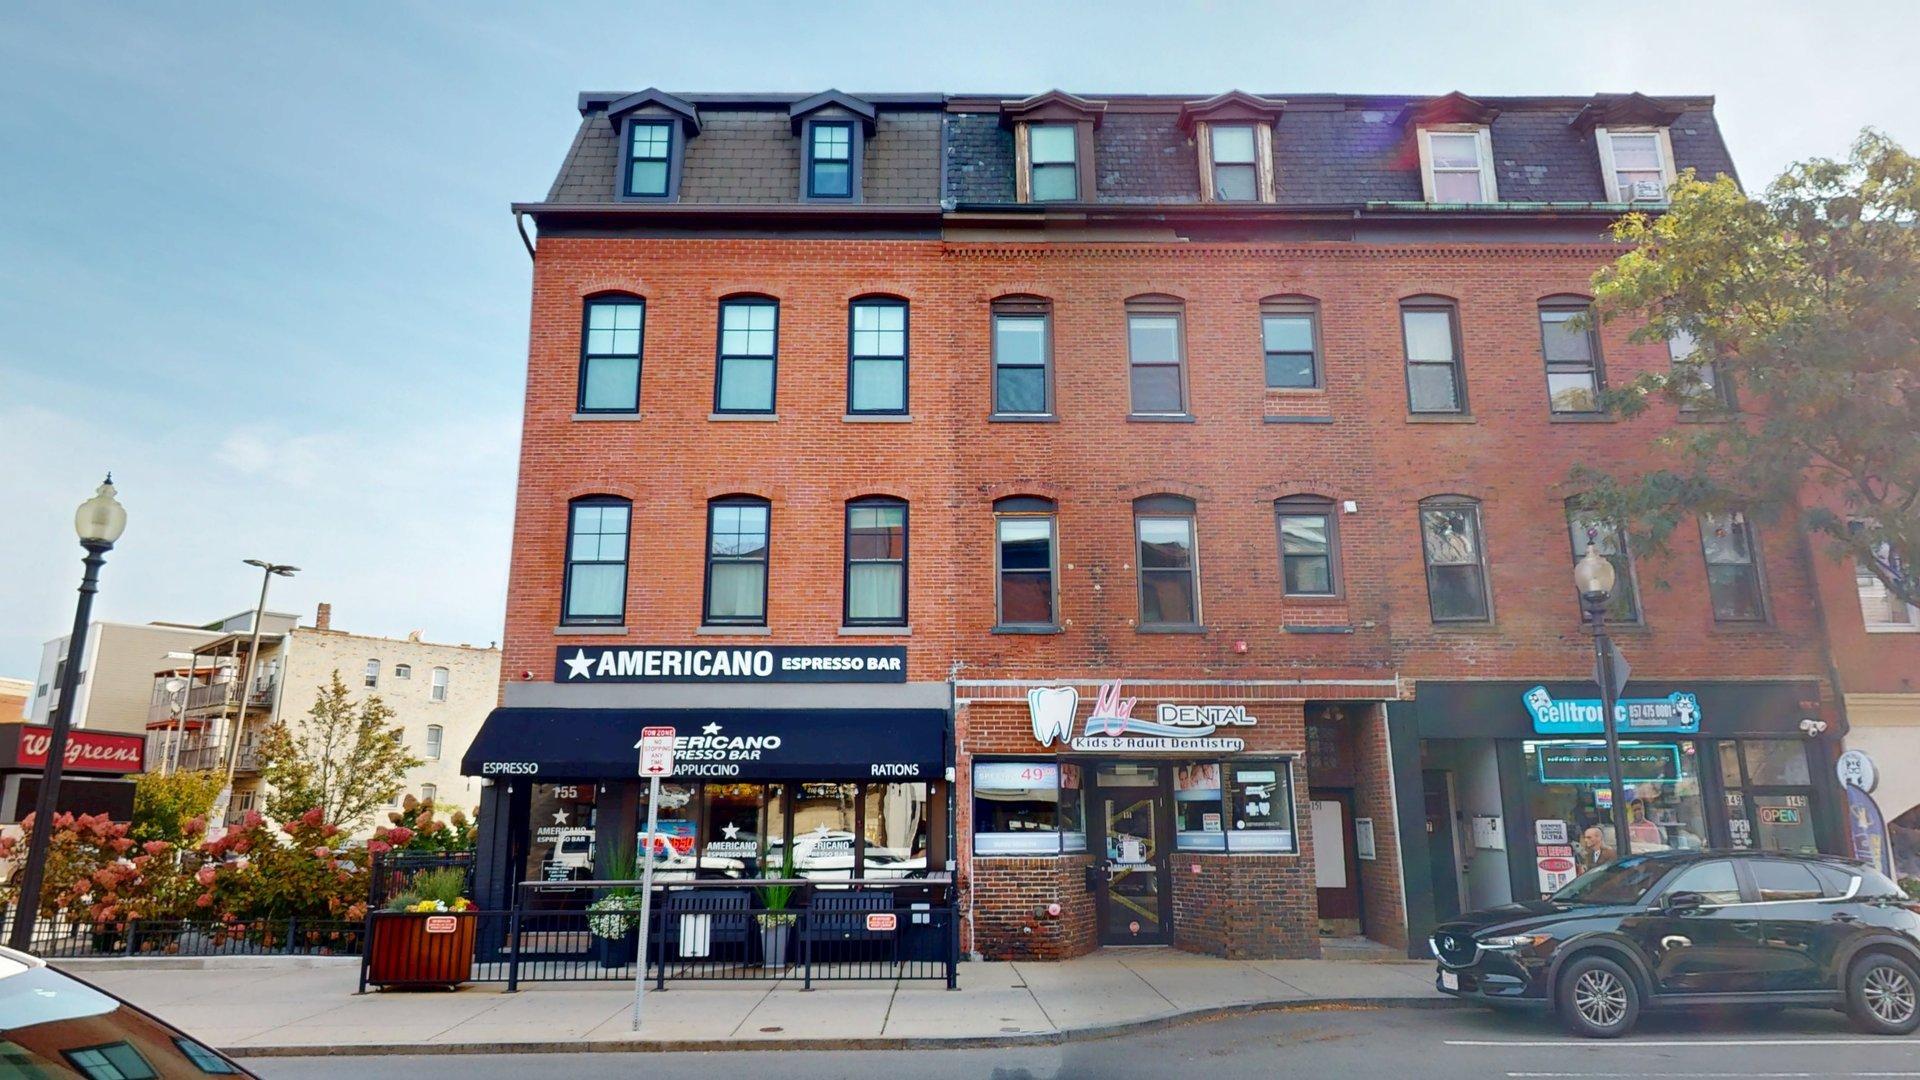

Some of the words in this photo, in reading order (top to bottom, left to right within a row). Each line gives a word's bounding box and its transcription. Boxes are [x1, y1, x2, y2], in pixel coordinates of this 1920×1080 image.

[596, 650, 773, 676] AMERICANO
[782, 657, 864, 670] ESPRESSO
[867, 657, 900, 670] BAR
[1161, 705, 1254, 725] DENTAL
[1538, 702, 1627, 722] celltroc
[23, 734, 140, 763] Wlgreens
[633, 736, 781, 749] ERICANO
[1076, 737, 1108, 748] Kids
[1113, 738, 1123, 748] &
[1127, 737, 1166, 748] Adult
[1171, 737, 1242, 750] Dentistry
[673, 750, 725, 760] RESSO
[728, 750, 761, 760] BAR
[483, 762, 539, 774] ESPRESSO
[673, 764, 739, 776] APPUCCINO
[871, 764, 919, 776] RATIONS
[1021, 768, 1043, 781] 49
[552, 786, 578, 798] 155
[1763, 809, 1797, 821] OPEN
[537, 827, 587, 835] AMERICANO
[707, 842, 757, 850] AMERICANO
